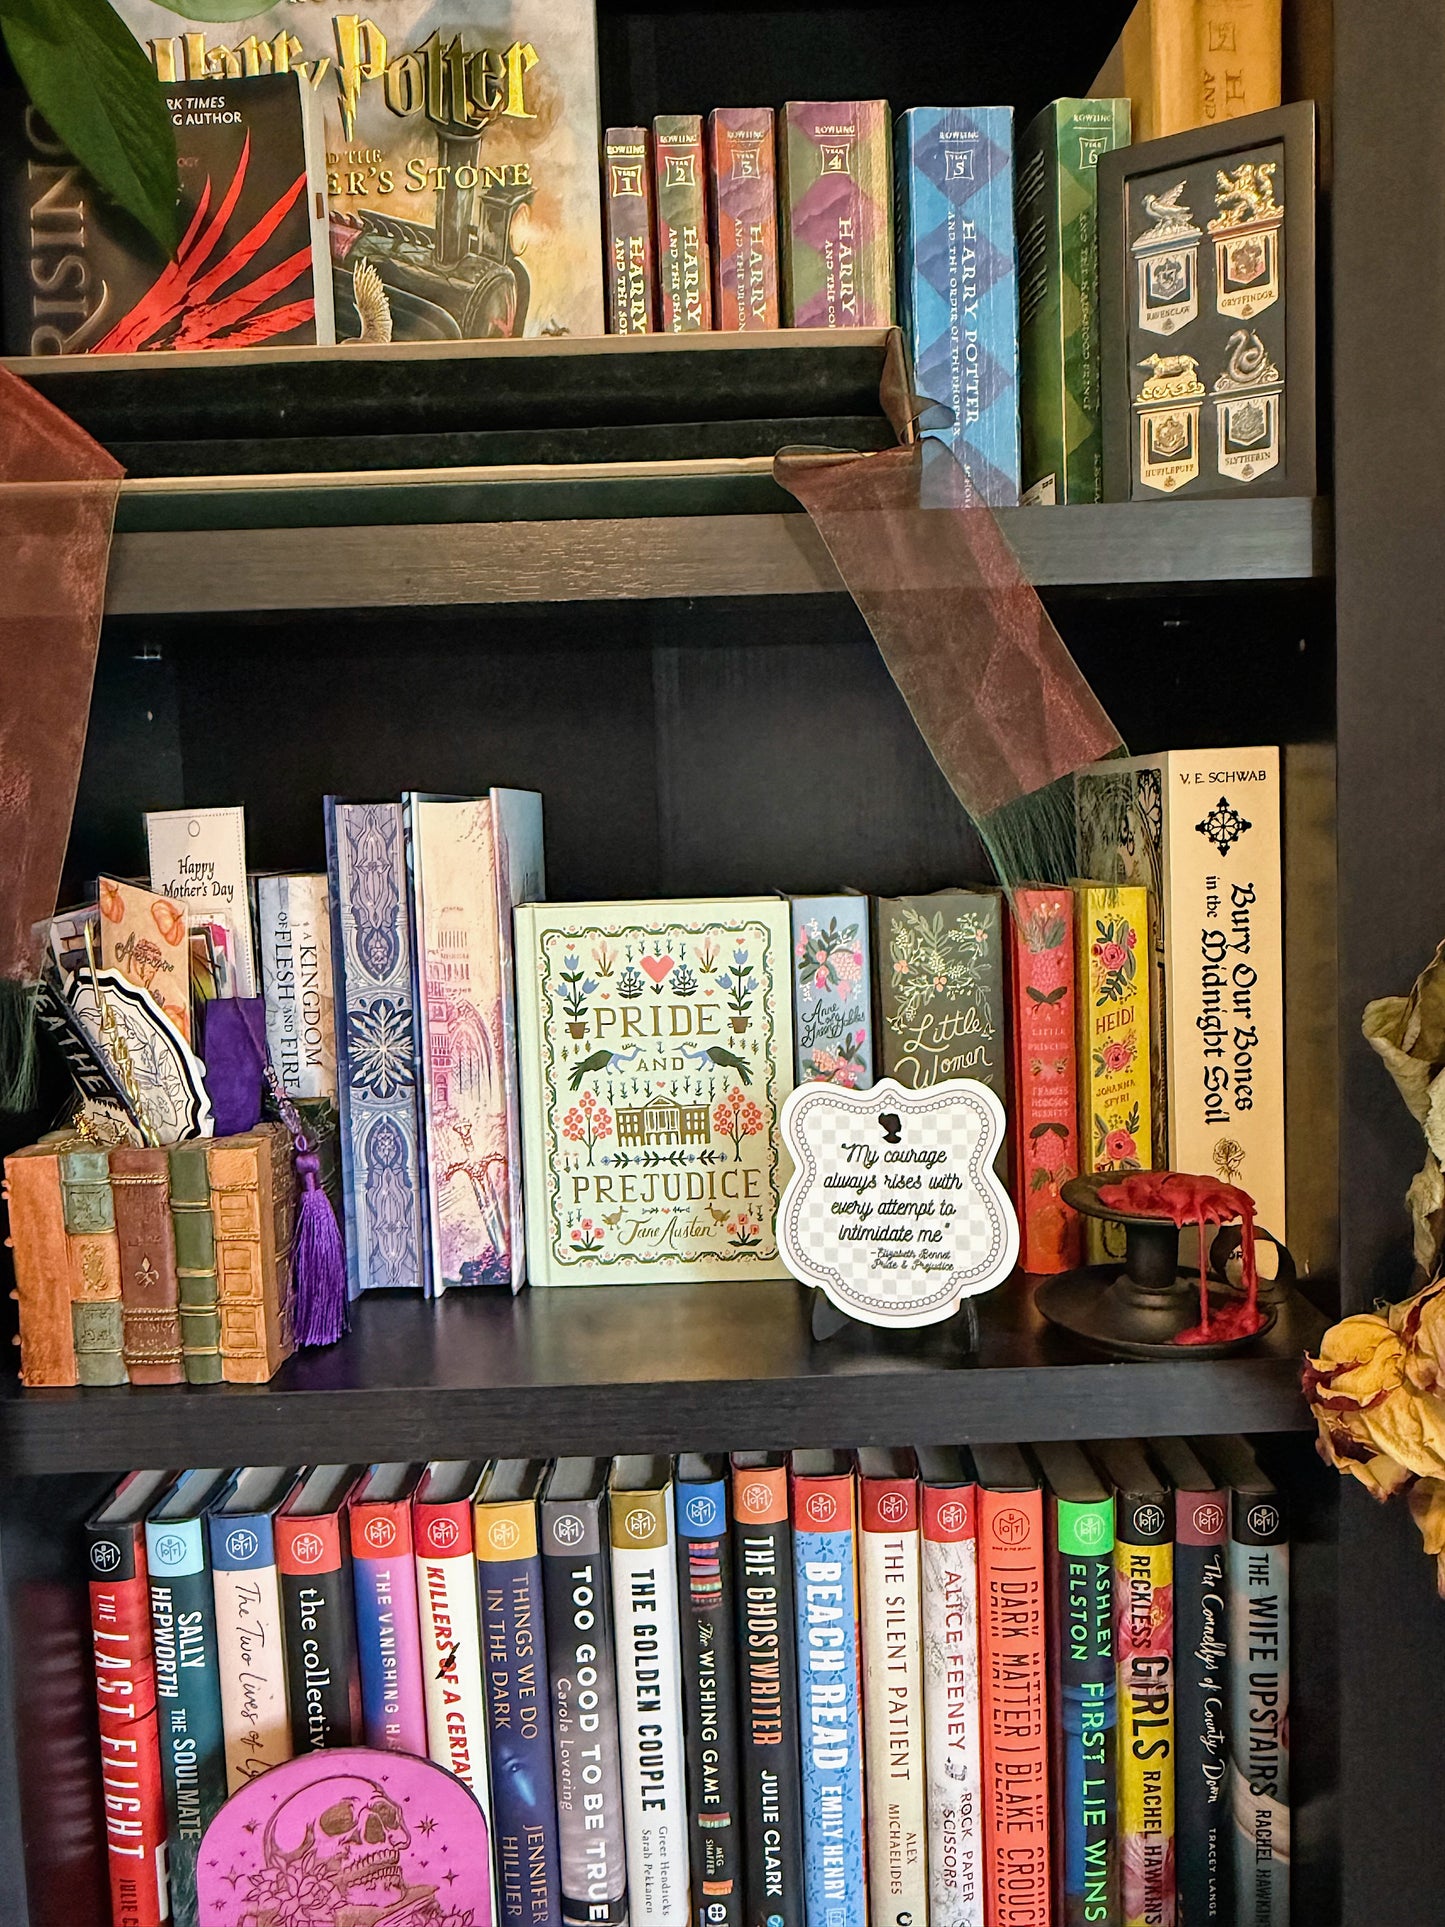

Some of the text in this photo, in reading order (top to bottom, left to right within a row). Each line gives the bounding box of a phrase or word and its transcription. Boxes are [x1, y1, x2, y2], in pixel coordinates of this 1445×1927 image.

[186, 96, 225, 110] TIMES
[332, 14, 540, 143] Potter
[1203, 69, 1217, 119] AND
[186, 111, 242, 126] AUTHOR
[406, 157, 534, 192] STONE
[622, 177, 634, 192] 1
[676, 168, 686, 182] 2
[742, 161, 752, 176] 3
[828, 155, 842, 170] 4
[953, 161, 965, 176] 5
[615, 237, 627, 272] AND
[734, 218, 745, 281] AND THE
[825, 239, 835, 269] AND
[947, 211, 956, 241] AND
[629, 236, 647, 334] HARRY
[668, 227, 681, 291] AND THE
[683, 226, 702, 326] HARRY
[750, 223, 767, 322] HARRY
[838, 216, 857, 316] HARRY
[948, 245, 958, 272] THE
[617, 276, 628, 307] THE
[825, 273, 836, 302] THE
[949, 277, 959, 322] ORDER
[961, 220, 980, 426] HARRY POTTER
[1208, 770, 1267, 784] SCHWAB
[162, 879, 234, 903] Mother's Day
[178, 855, 215, 881] Happy
[275, 911, 300, 1089] OF FLESH AND FIRE
[299, 944, 324, 1068] KINGDOM
[592, 1003, 721, 1039] PRIDE
[801, 998, 839, 1025] Anne
[1096, 1006, 1135, 1035] HEIDI
[1196, 875, 1231, 1126] in the Midnight Soil
[1225, 882, 1259, 1111] Bury Our Bones
[903, 1006, 983, 1053] Little
[636, 1057, 685, 1072] AND
[893, 1045, 993, 1090] Women
[1096, 1080, 1135, 1098] JOHANNA
[572, 1168, 762, 1205] PREJUDICE
[824, 1172, 963, 1195] always rises with
[884, 1149, 947, 1170] courage
[617, 1215, 717, 1250] Jane Austen
[831, 1199, 957, 1221] every attempt to
[838, 1223, 914, 1241] intimidate
[871, 1258, 954, 1273] Pride Prejudice
[919, 1248, 951, 1260] Bennet
[300, 1588, 325, 1631] the
[805, 1562, 845, 1672] BEACH
[944, 1570, 963, 1644] ALICE
[1001, 1582, 1029, 1638] DARK
[1069, 1563, 1089, 1661] ELSTON
[93, 1594, 135, 1718] THE LAST
[178, 1611, 206, 1668] SALLY
[235, 1582, 268, 1726] The Two Lives
[376, 1570, 400, 1714] THE VANISHING
[426, 1566, 462, 1706] KILLERS A
[151, 1586, 202, 1841] HEPWORTH THE SOULMATE
[744, 1535, 783, 1897] THE GHOSTWRITER JULIE CLARK
[884, 1540, 917, 1865] THE SILENT PATIENT ALEX
[947, 1654, 965, 1750] FEENEY
[1002, 1654, 1031, 1737] MATTER
[1248, 1553, 1279, 1866] THE WIFE UPSTAIRS RACHEL
[487, 1589, 523, 1917] IN THE DARK HILLIER
[512, 1571, 548, 1924] THINGS WE DO JENNIFER
[557, 1677, 577, 1811] Carola Lovering
[571, 1565, 609, 1921] TOO GOOD TO BE TRUE
[631, 1568, 672, 1916] THE GOLDEN COUPLE Greer Hendricks
[699, 1650, 721, 1804] WISHING GAME
[810, 1684, 849, 1770] READ
[1081, 1563, 1112, 1922] ASHLEY FIRST LIE WINS
[1130, 1555, 1170, 1925] RECKLESS GIRLS RACHEL HAWKINS
[1194, 1553, 1228, 1917] The Connellys County TRACEY LANGE
[821, 1785, 844, 1838] EMILY
[960, 1792, 973, 1842] ROCK
[1005, 1763, 1034, 1834] BLAKE
[641, 1829, 654, 1914] Sarah Pekkanen
[823, 1844, 846, 1901] HENRY
[888, 1803, 902, 1895] MICHAELIDES
[942, 1808, 957, 1889] SCISSORS
[962, 1850, 974, 1903] PAPER
